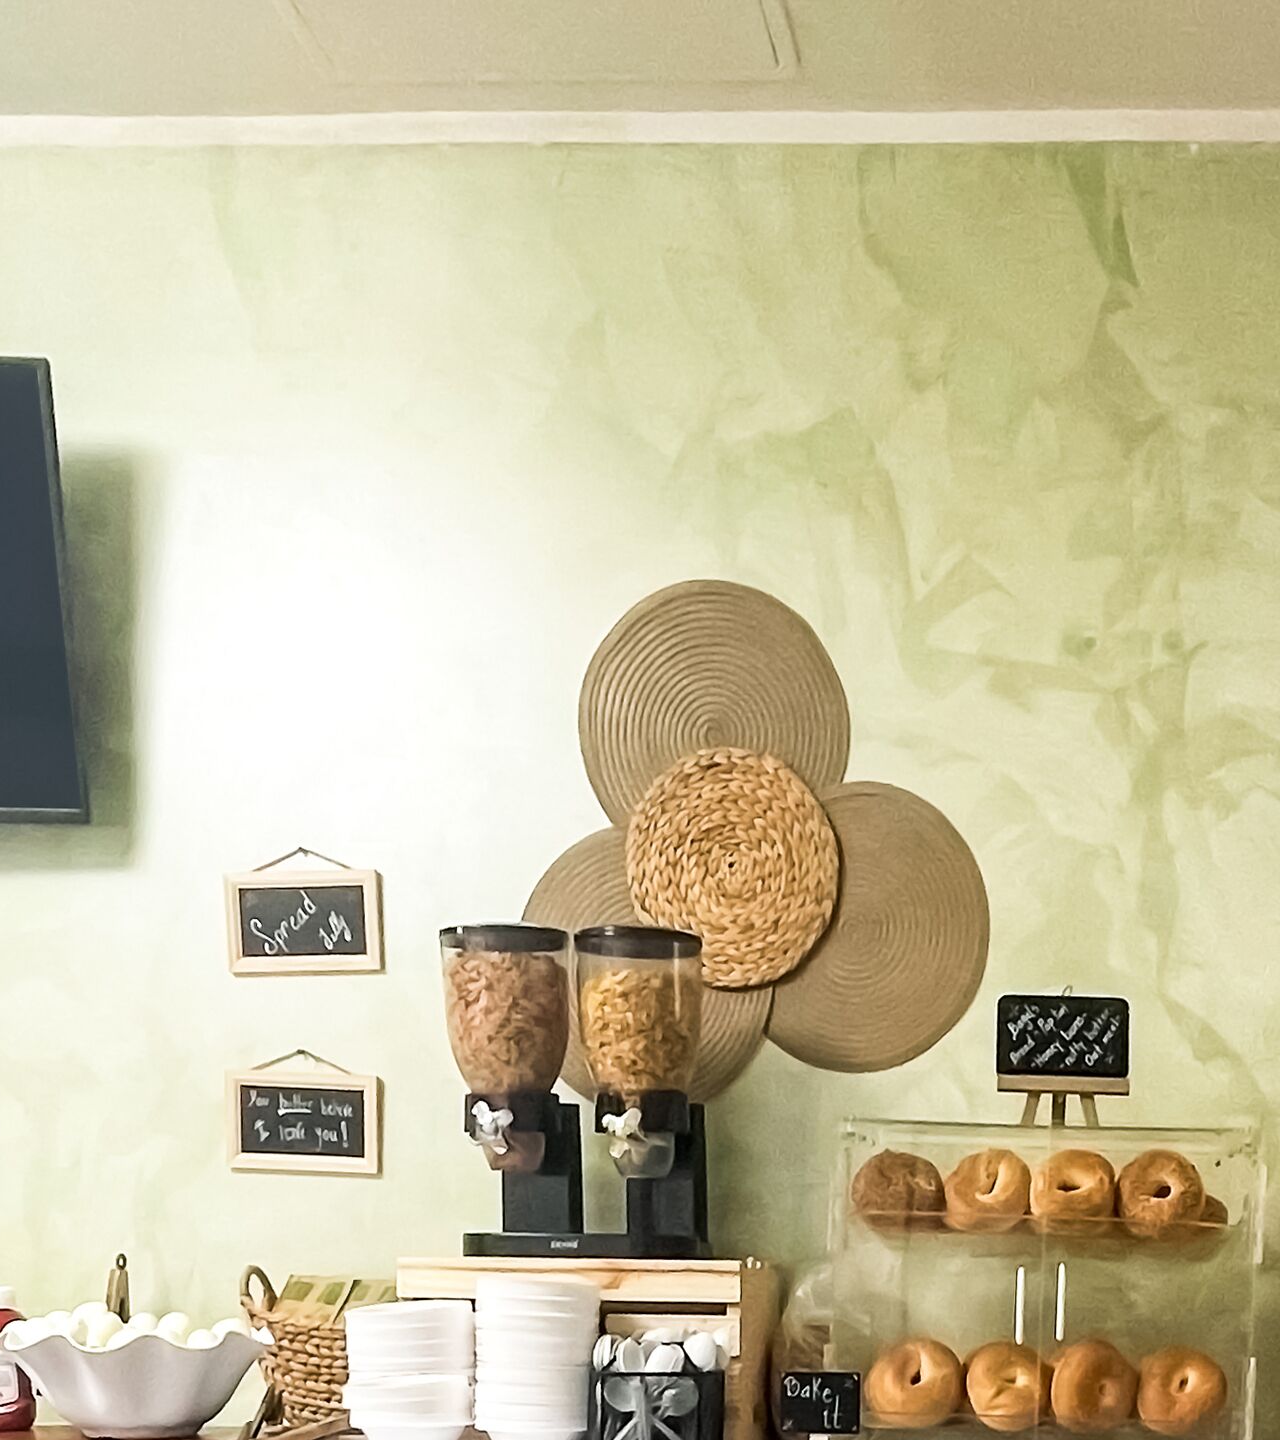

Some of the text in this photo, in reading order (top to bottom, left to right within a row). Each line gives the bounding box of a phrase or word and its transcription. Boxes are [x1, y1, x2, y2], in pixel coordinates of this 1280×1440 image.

[249, 889, 317, 955] Spread
[783, 1375, 833, 1404] Bake
[822, 1394, 842, 1430] it
